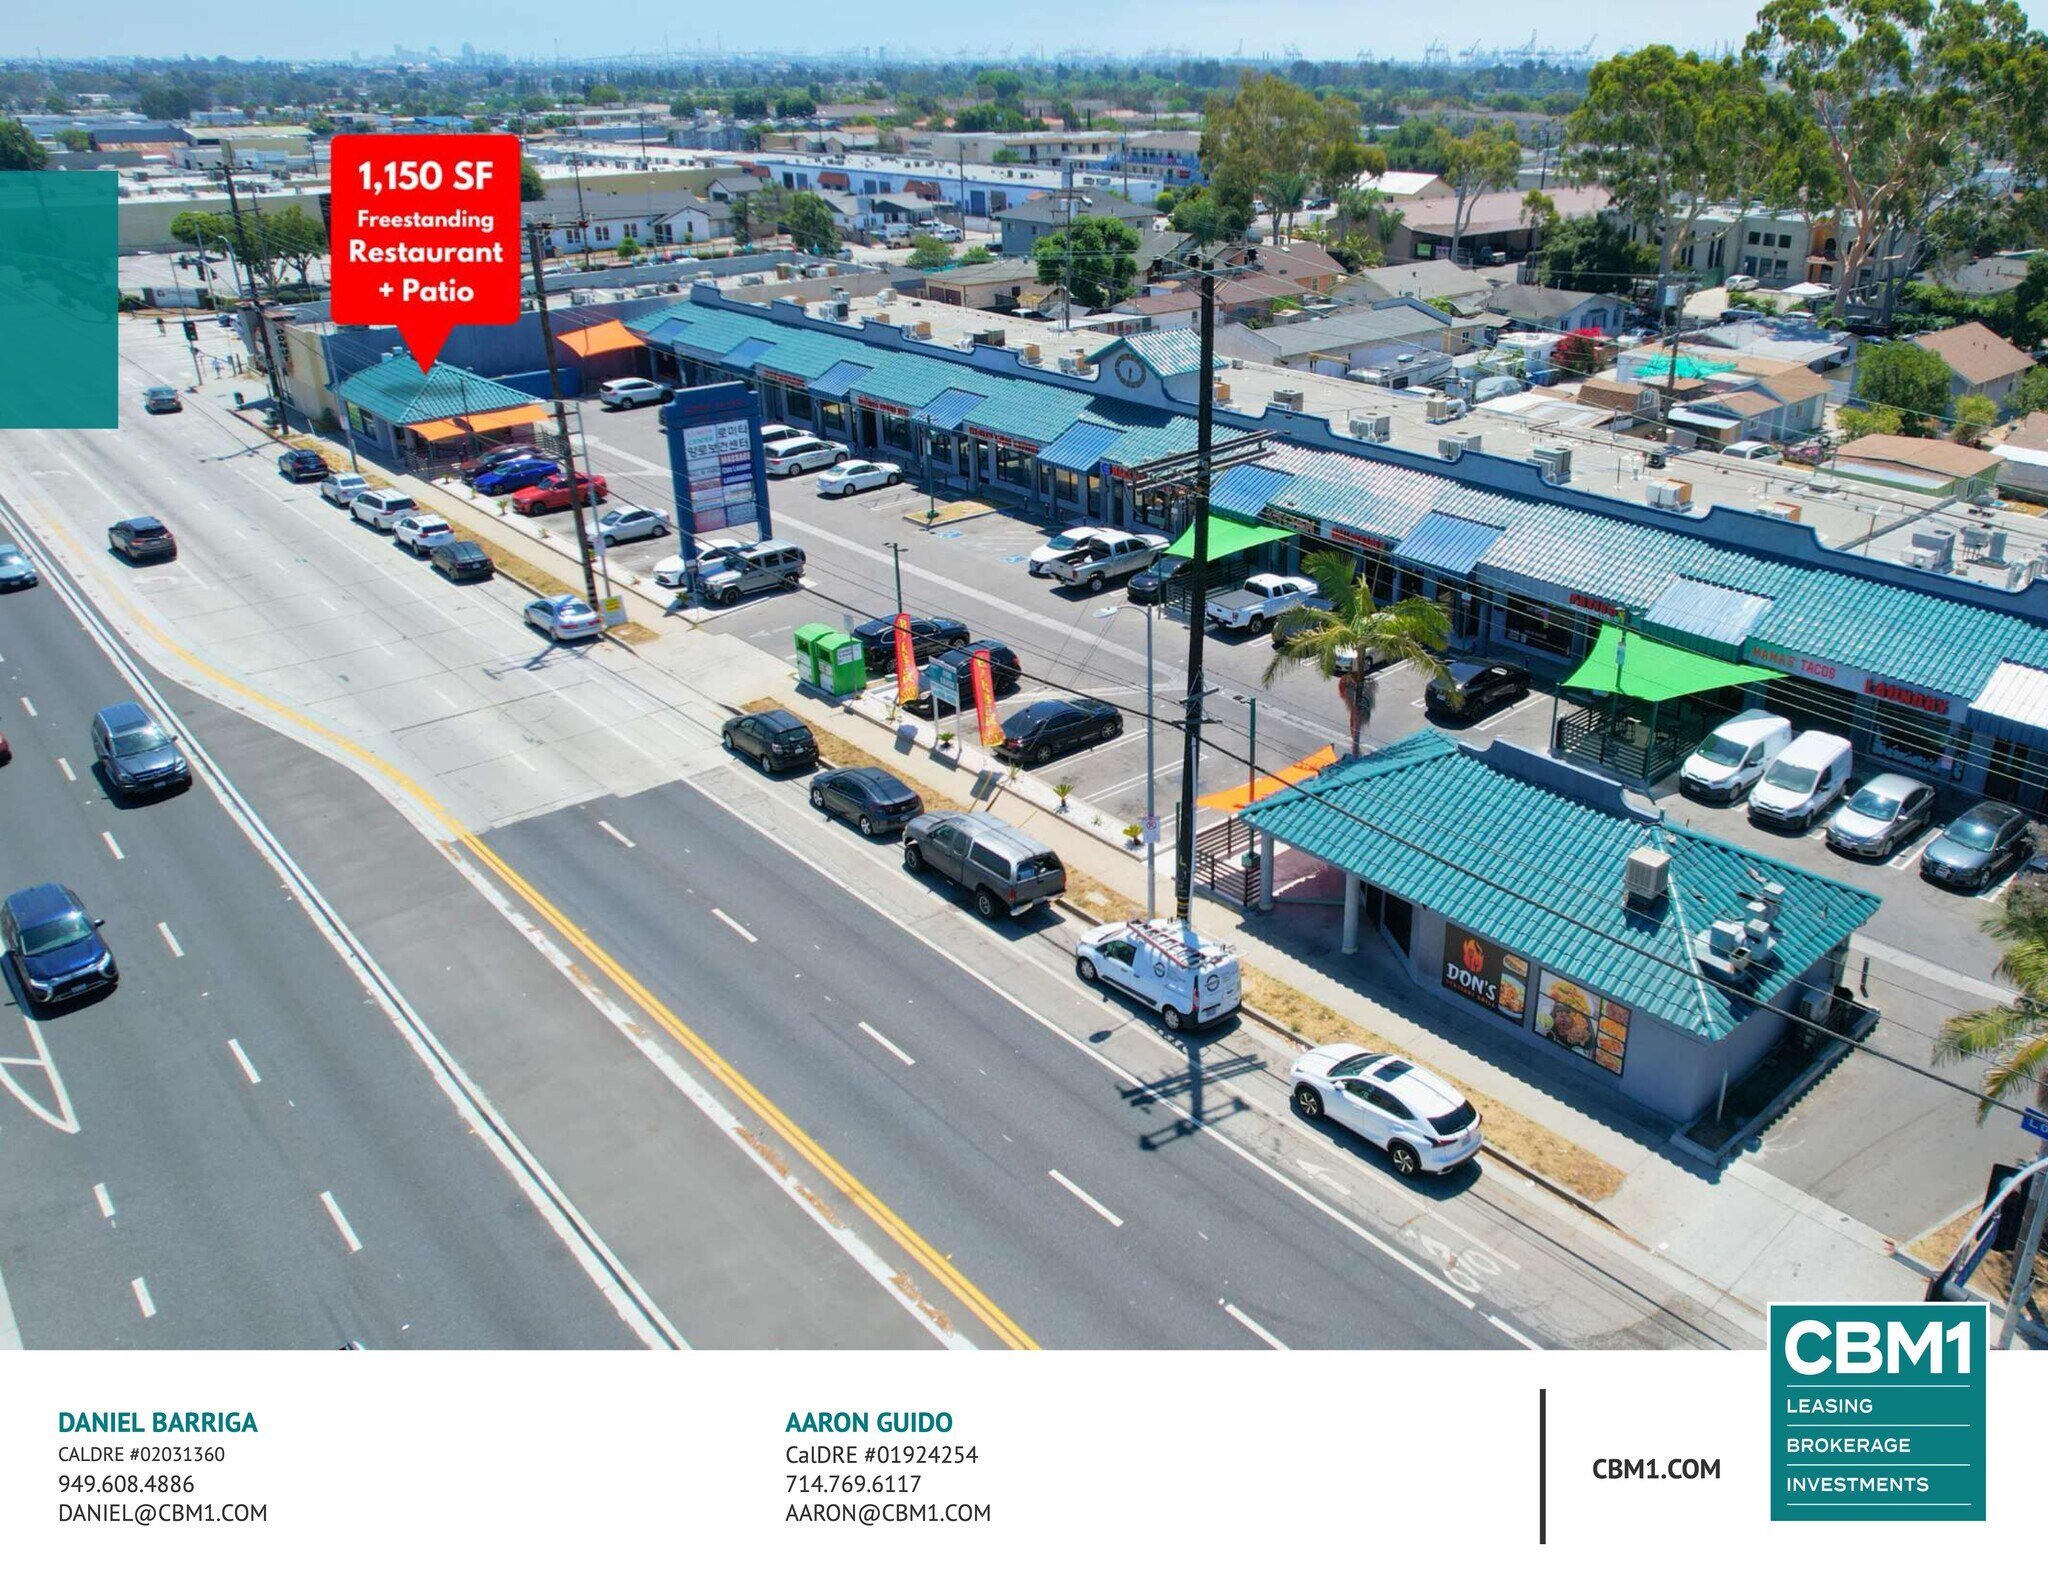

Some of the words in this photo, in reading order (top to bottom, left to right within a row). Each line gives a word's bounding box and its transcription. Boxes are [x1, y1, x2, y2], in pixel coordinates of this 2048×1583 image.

[1800, 659, 1837, 680] TACOS
[1863, 677, 1950, 716] LAUNDRY
[1447, 962, 1497, 1001] DON'S
